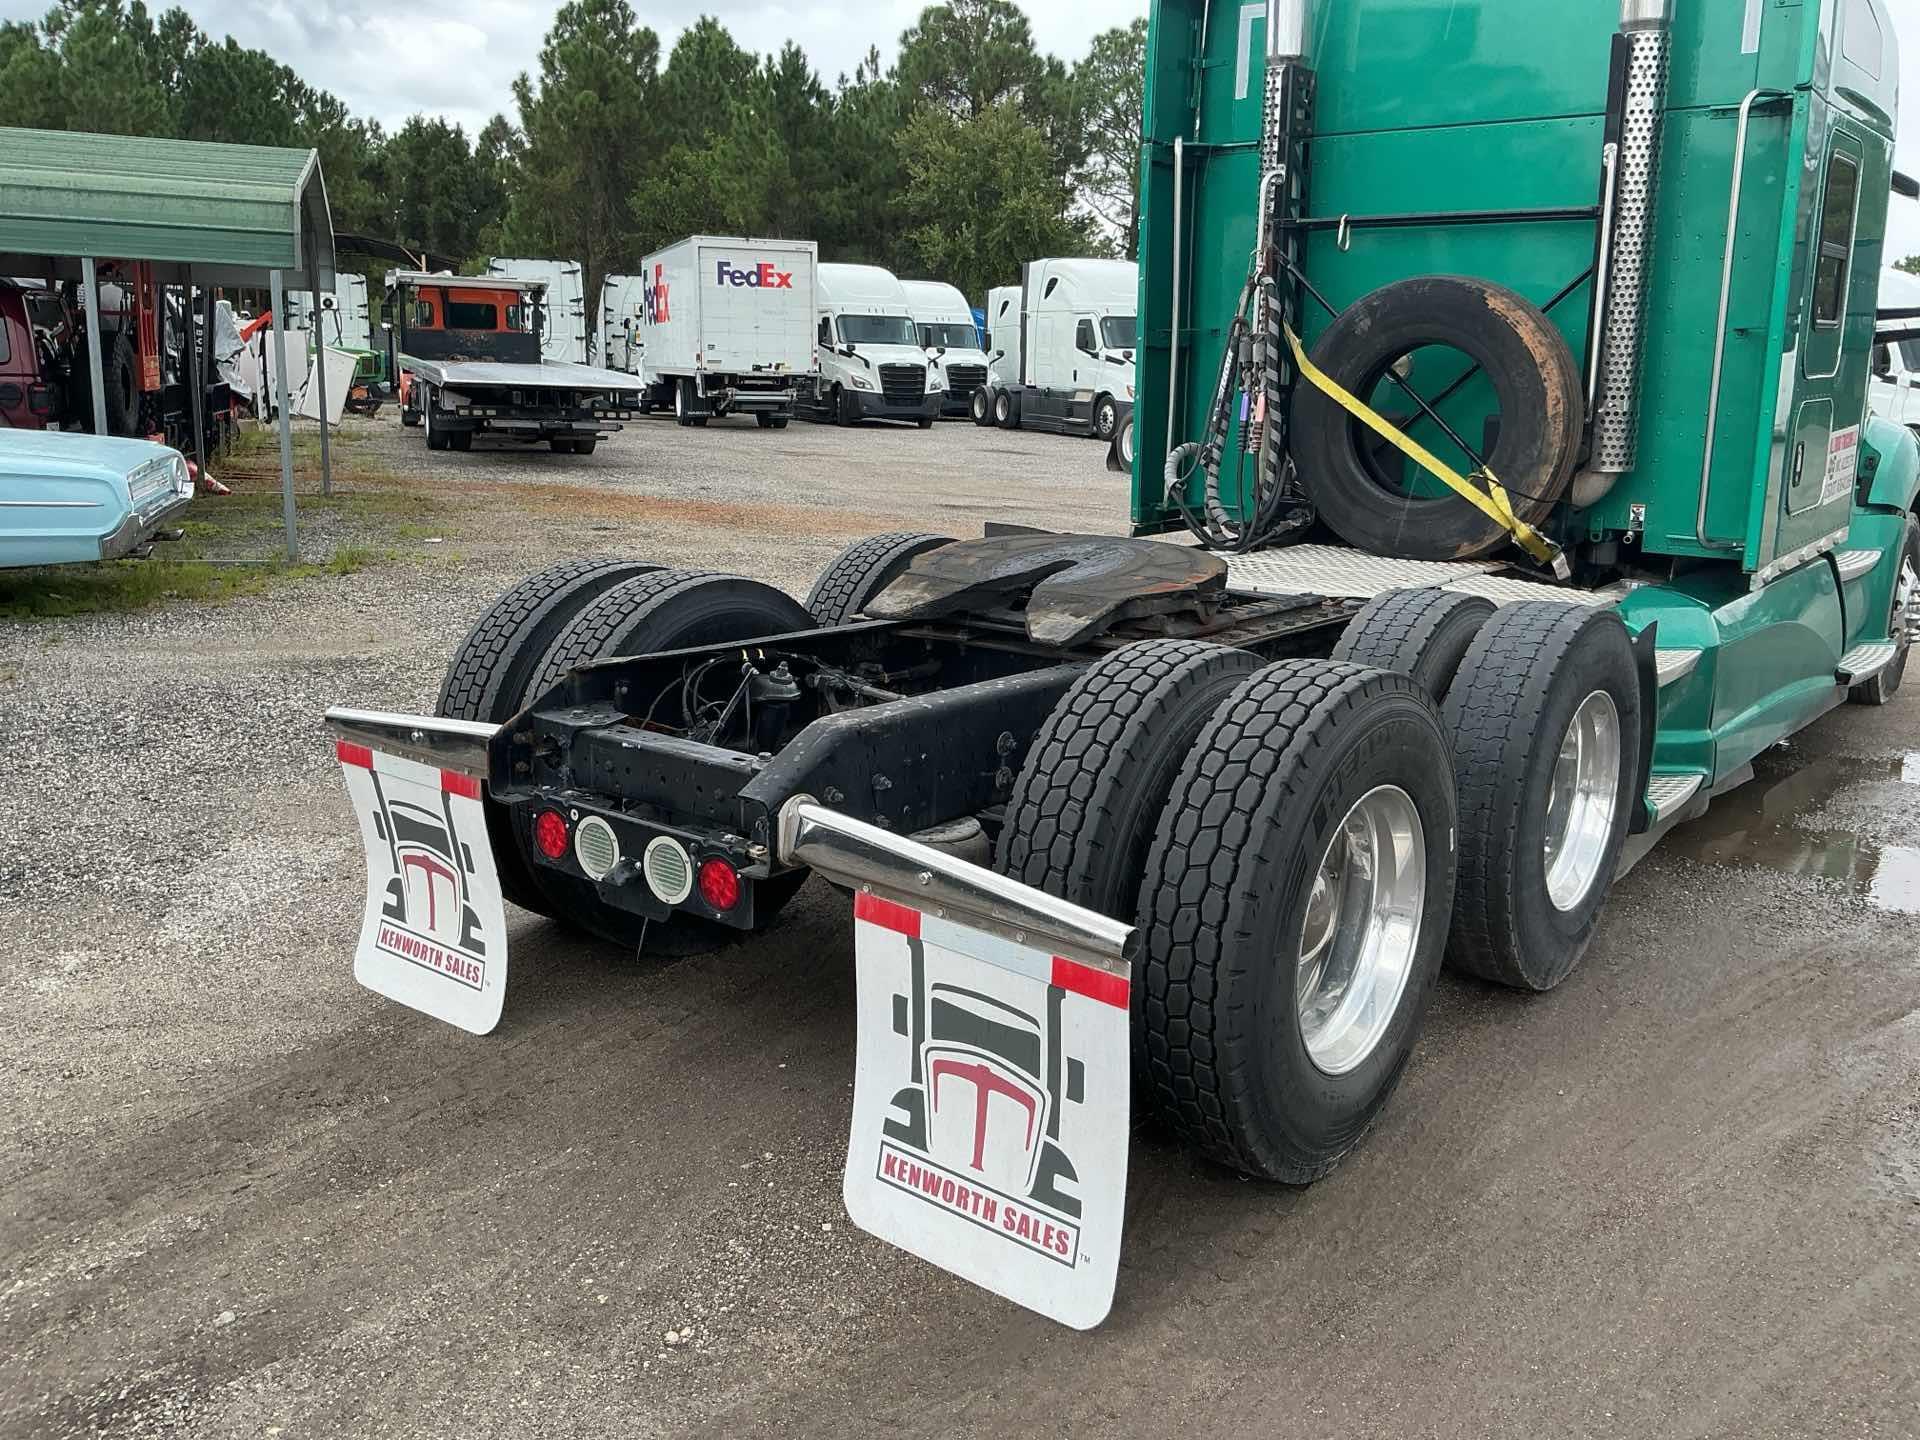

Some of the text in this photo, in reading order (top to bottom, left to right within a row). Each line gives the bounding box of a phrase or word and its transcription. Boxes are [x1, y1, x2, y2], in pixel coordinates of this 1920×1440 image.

[717, 261, 793, 289] FedEx
[380, 927, 480, 983] KENWORTH SALES
[884, 1153, 1070, 1255] KENWORTH SALES
[1079, 1252, 1091, 1265] TM
